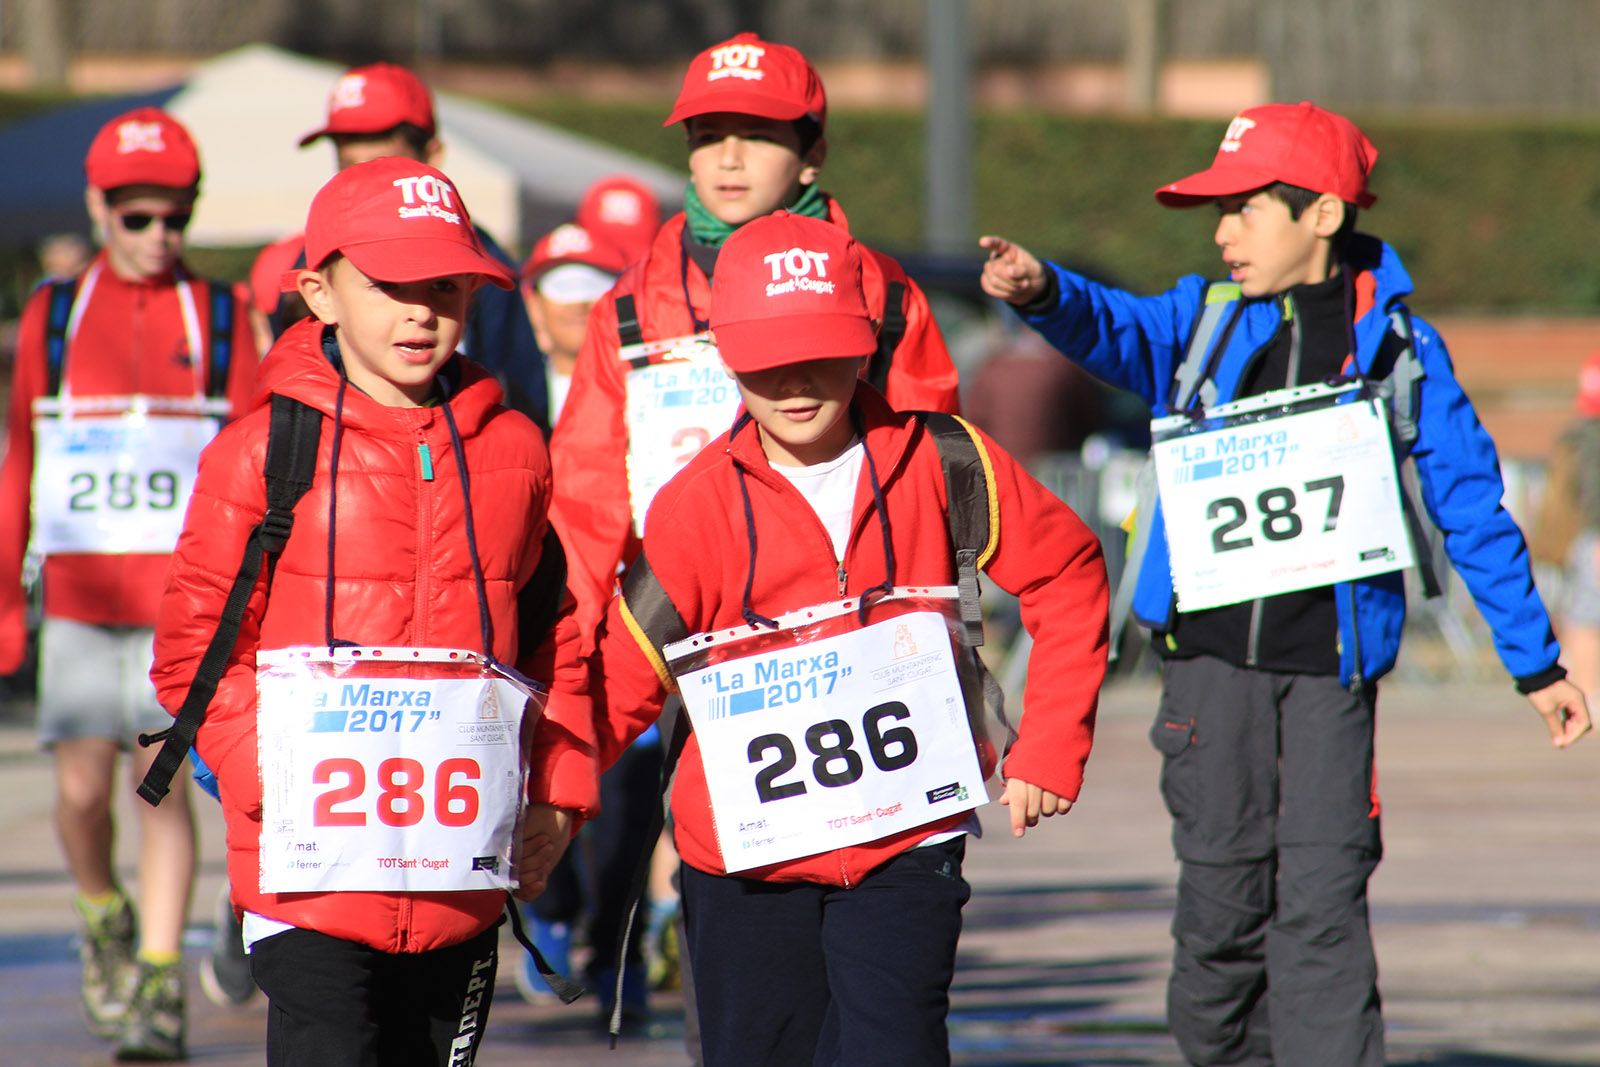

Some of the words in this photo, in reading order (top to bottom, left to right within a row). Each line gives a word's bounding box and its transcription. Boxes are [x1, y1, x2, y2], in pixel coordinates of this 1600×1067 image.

[710, 44, 766, 69] TOT
[1225, 117, 1257, 140] OT
[392, 175, 453, 208] TOT
[763, 247, 830, 281] TOT
[765, 278, 797, 297] Sant
[799, 276, 836, 294] Cugat
[1215, 431, 1288, 457] Marxa
[68, 469, 180, 512] 289
[1206, 475, 1345, 554] 287
[754, 650, 840, 685] Marxa
[341, 684, 432, 707] Marxa
[747, 701, 919, 804] 286
[312, 757, 481, 827] 286
[827, 817, 849, 830] TOT
[850, 811, 873, 825] Sant
[296, 859, 322, 869] ferrer
[377, 857, 397, 868] TOT
[398, 857, 418, 868] Sant
[421, 857, 449, 870] Cugat
